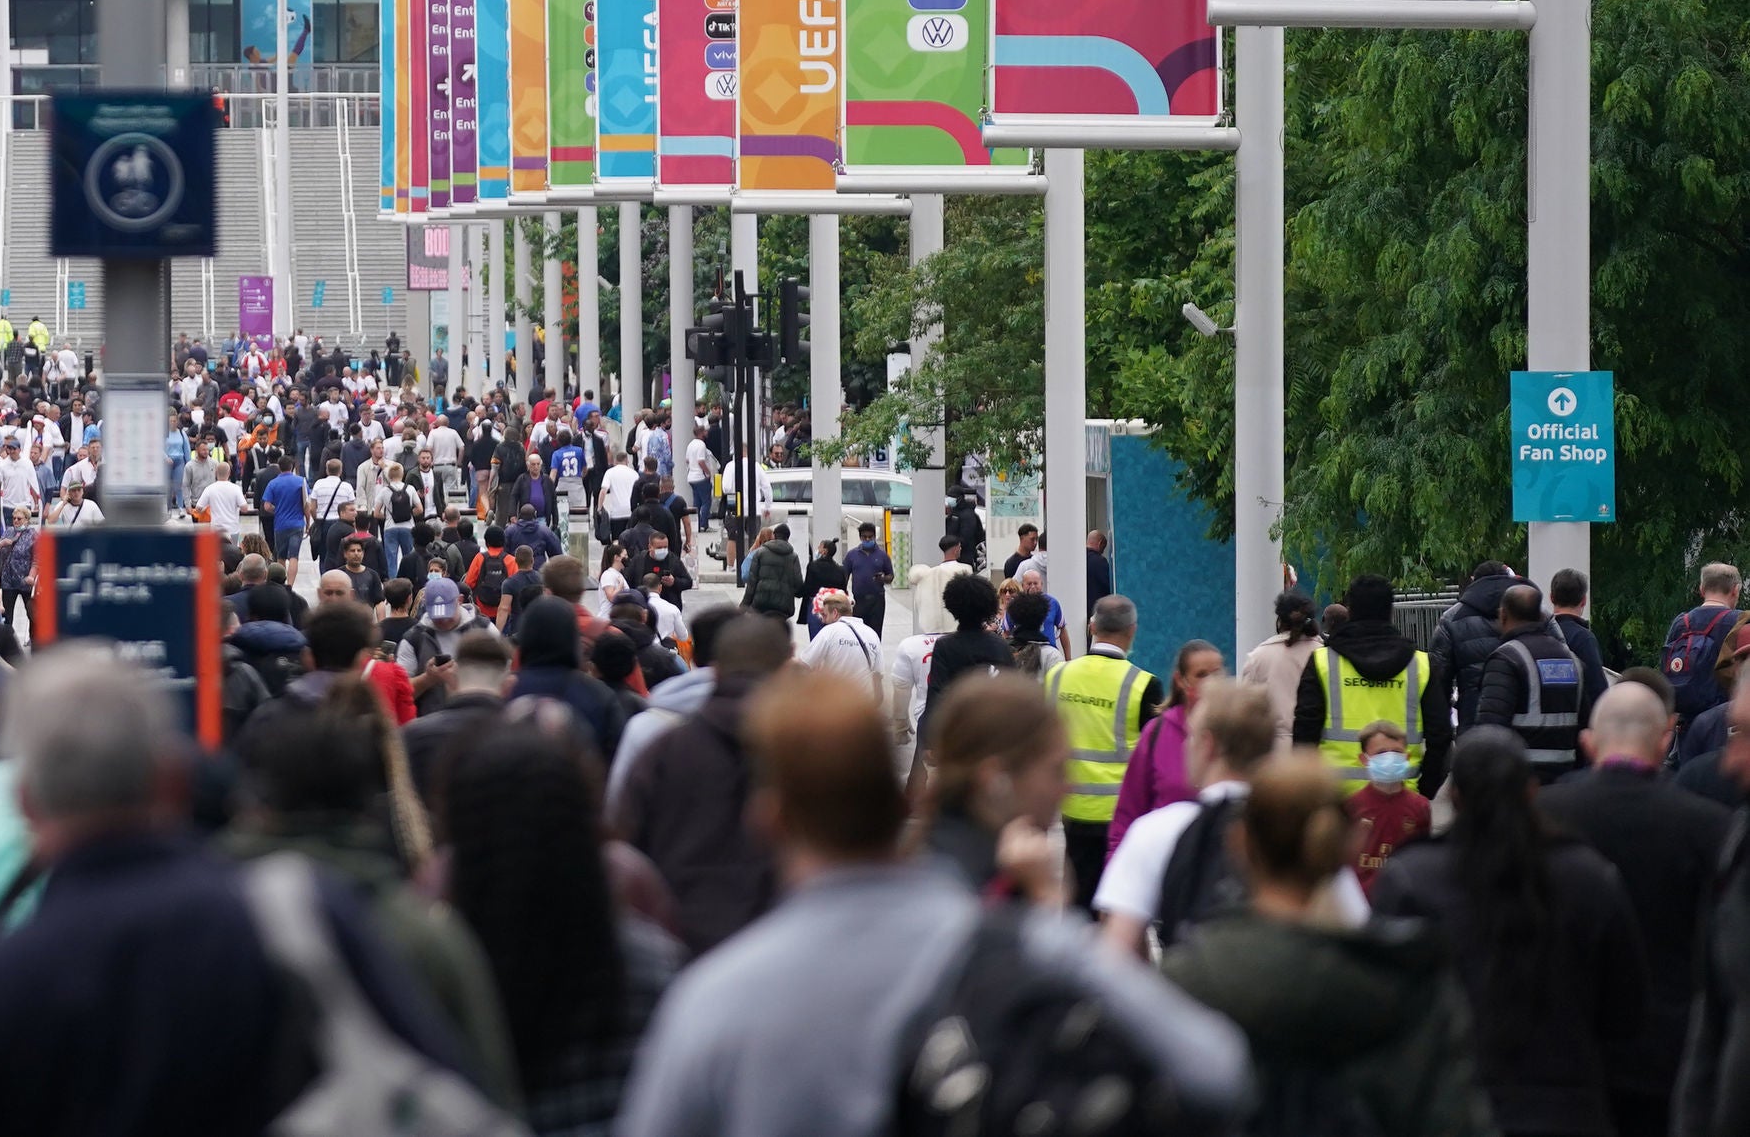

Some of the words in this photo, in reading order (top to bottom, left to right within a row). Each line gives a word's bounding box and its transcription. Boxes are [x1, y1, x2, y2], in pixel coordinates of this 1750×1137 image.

[1527, 423, 1599, 440] Official
[1519, 445, 1554, 461] Fan
[1559, 444, 1608, 464] Shop
[562, 457, 579, 477] 33
[1343, 676, 1405, 690] SECURITY
[1059, 690, 1114, 710] SECURITY
